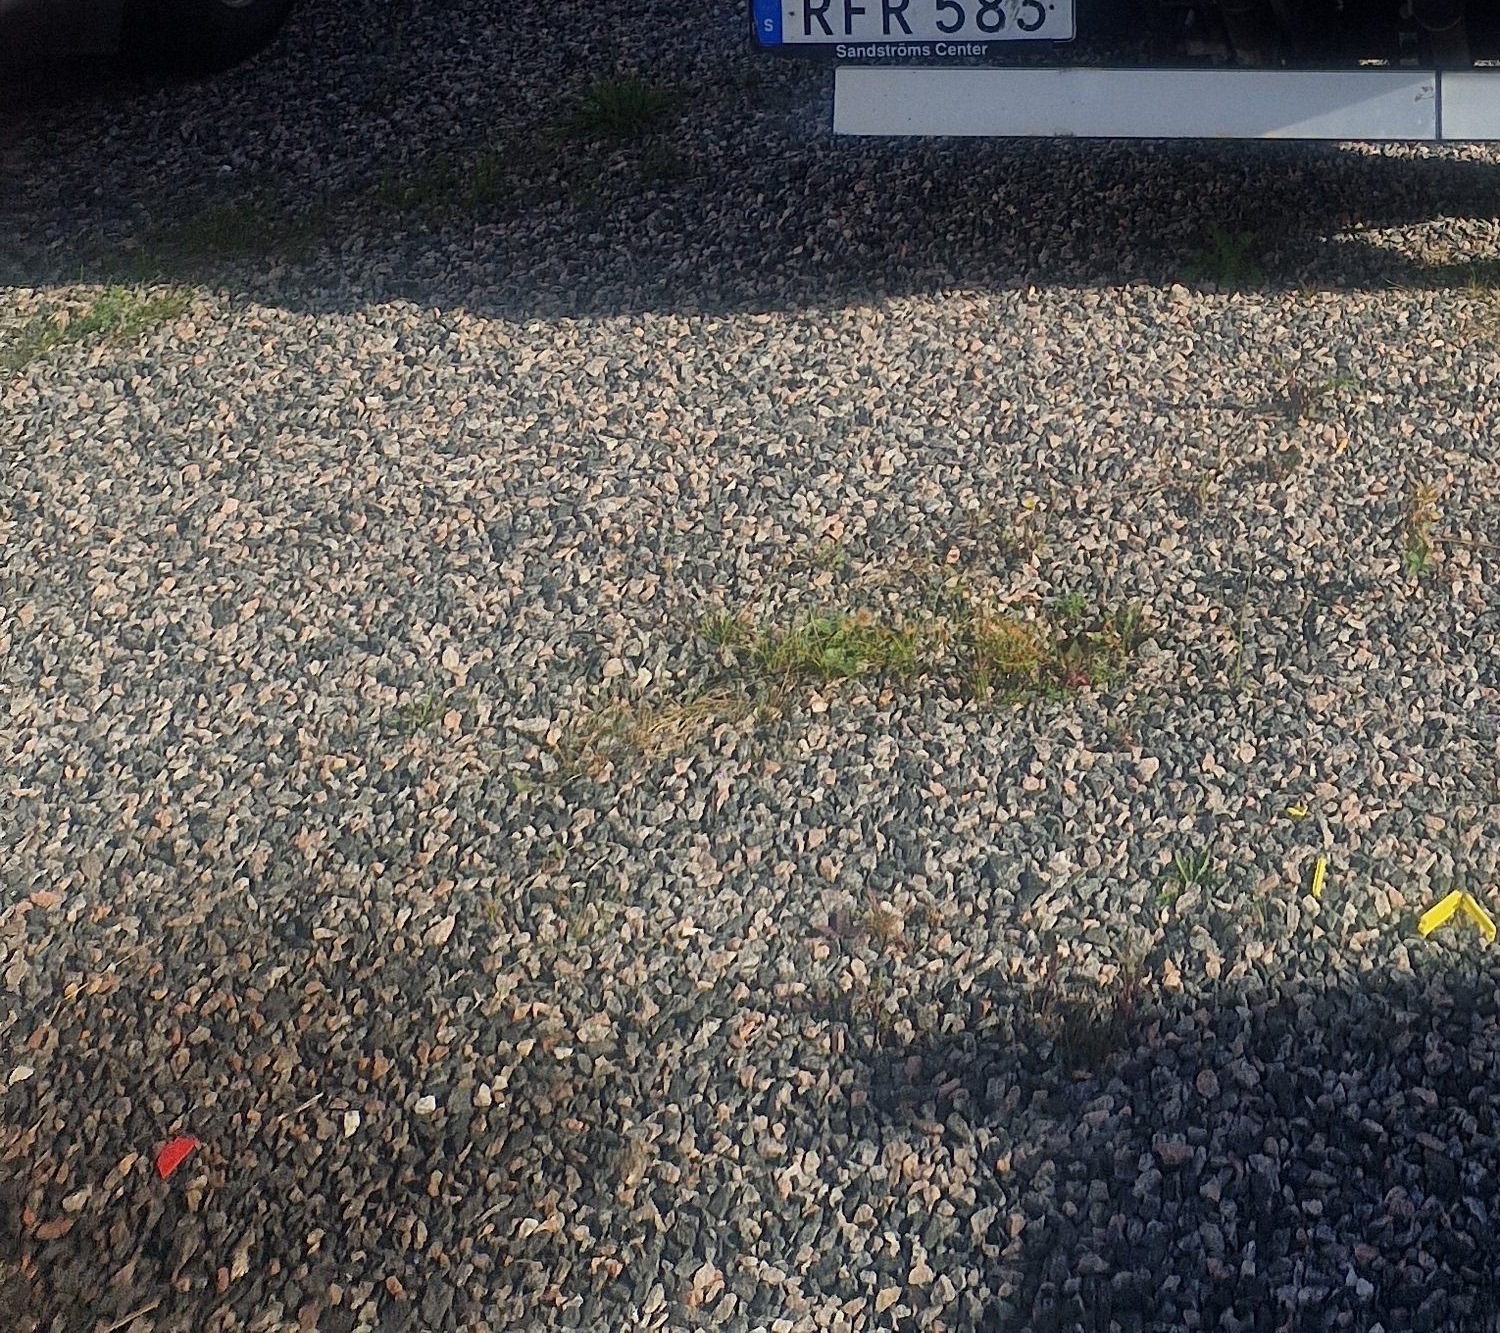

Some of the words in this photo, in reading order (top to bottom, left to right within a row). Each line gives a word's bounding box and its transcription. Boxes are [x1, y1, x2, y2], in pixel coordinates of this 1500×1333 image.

[763, 19, 774, 33] S
[835, 44, 931, 58] Sandströms
[935, 42, 989, 57] Center
